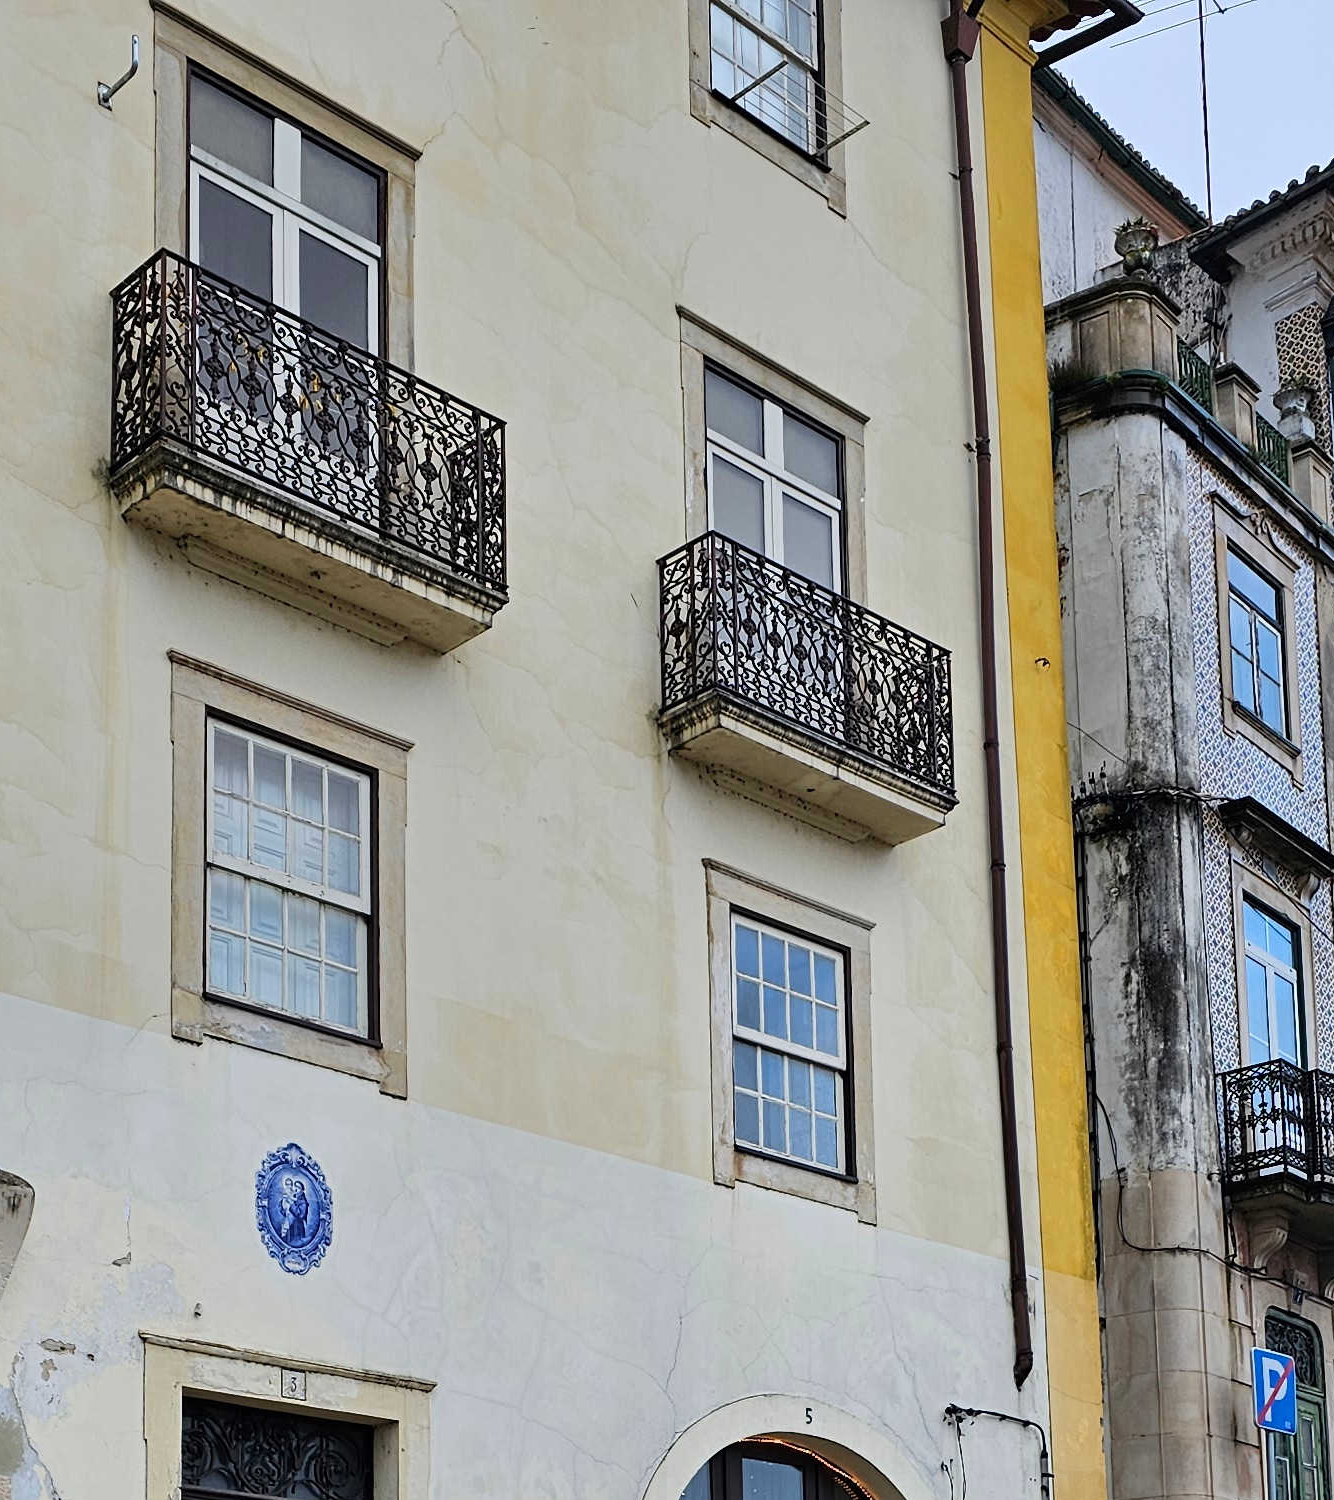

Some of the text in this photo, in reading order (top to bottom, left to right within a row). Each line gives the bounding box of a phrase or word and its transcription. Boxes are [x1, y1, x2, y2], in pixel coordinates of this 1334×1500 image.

[290, 1376, 297, 1393] 3
[1261, 1356, 1288, 1422] P
[805, 1407, 813, 1425] 5
